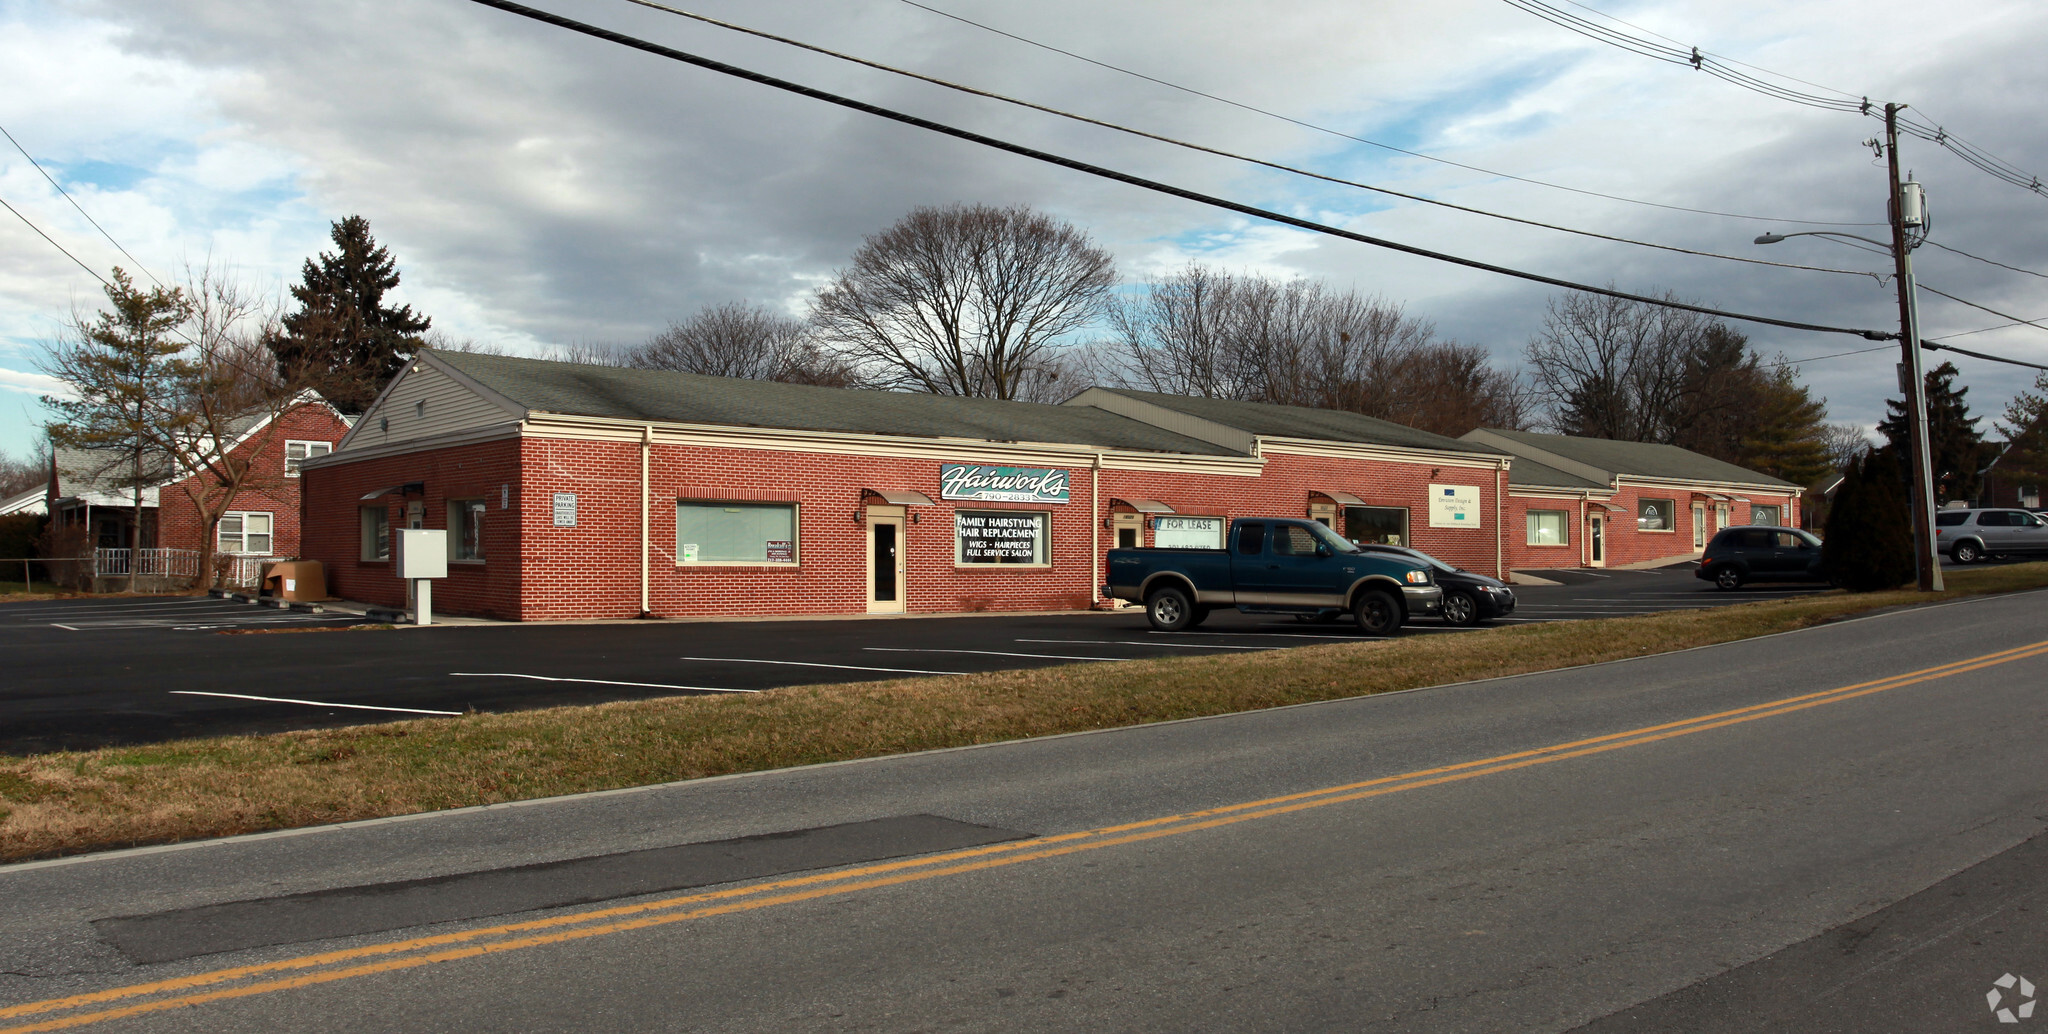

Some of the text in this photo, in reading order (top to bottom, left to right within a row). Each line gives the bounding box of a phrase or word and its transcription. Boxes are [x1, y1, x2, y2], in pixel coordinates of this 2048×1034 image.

[942, 466, 1068, 496] Hairworks
[984, 492, 1031, 501] 790-2833
[957, 517, 1042, 528] FAMILY HAIRSTYLING
[1167, 519, 1212, 530] FOR LEASE
[959, 528, 1040, 538] HAIR REPLACEMENT
[994, 541, 1031, 549] HAIRPIECES
[966, 549, 982, 557] FULL
[983, 549, 1010, 557] SERVICE
